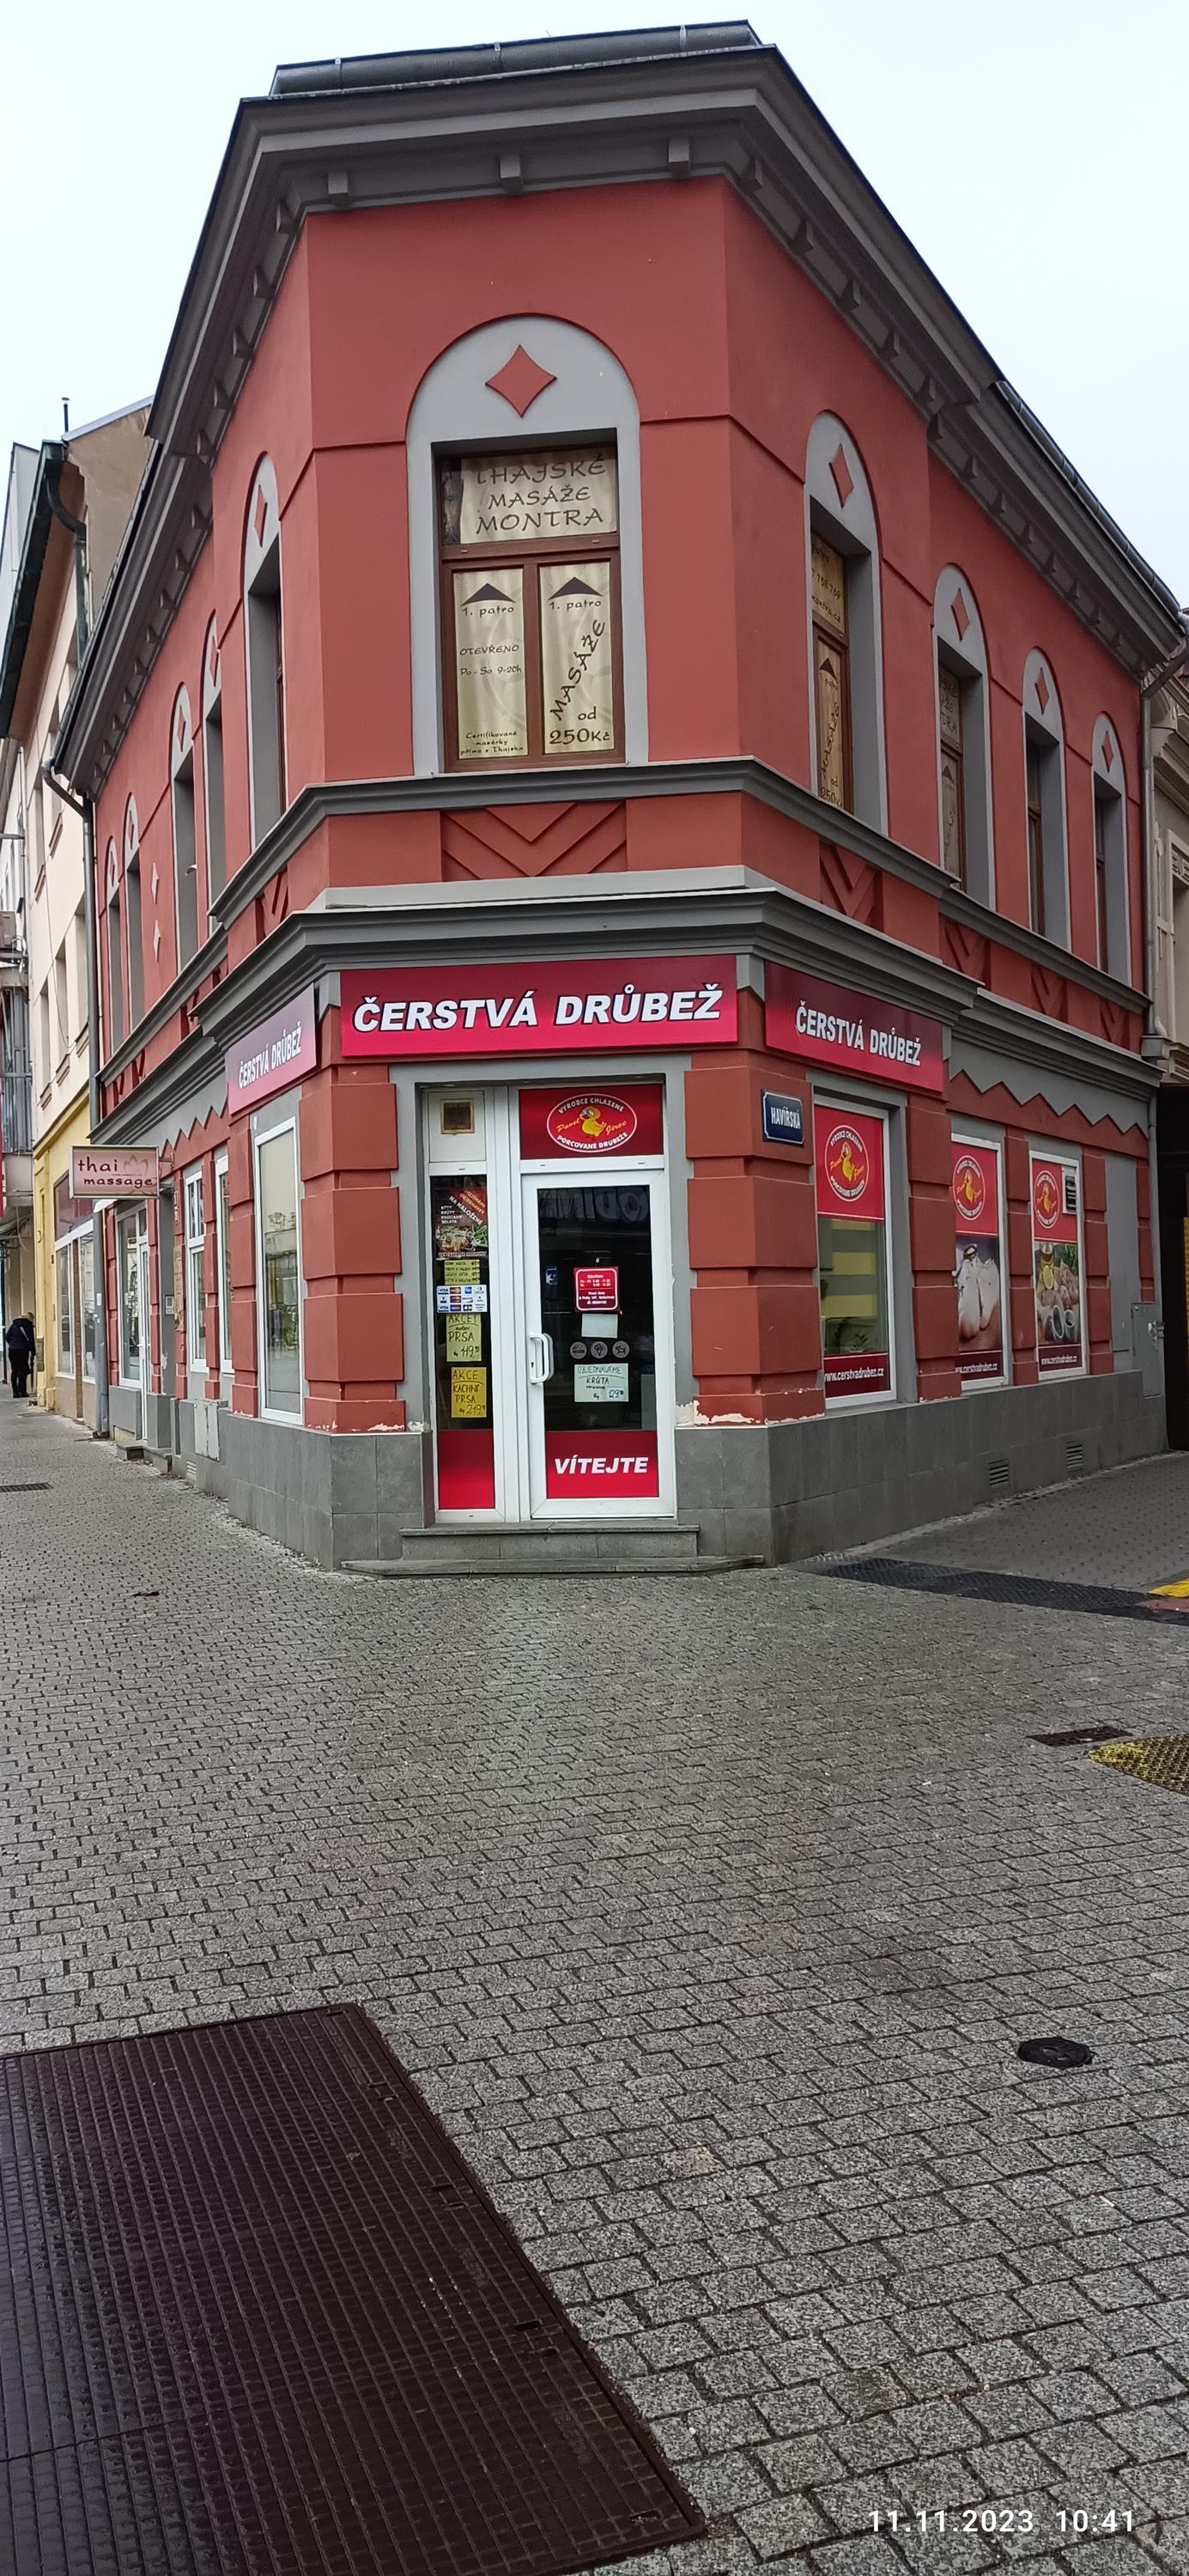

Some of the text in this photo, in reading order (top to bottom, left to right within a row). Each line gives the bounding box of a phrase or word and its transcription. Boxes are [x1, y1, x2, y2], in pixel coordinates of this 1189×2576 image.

[477, 454, 606, 484] THAJSKÉ
[488, 484, 591, 509] MASÁŽE
[476, 508, 604, 534] MONTRA
[480, 605, 514, 618] patro
[567, 599, 602, 611] patro
[460, 644, 519, 655] OTEVŘENO
[480, 666, 492, 675] So
[549, 619, 605, 720] MASÁŽE
[578, 706, 597, 720] od
[353, 983, 723, 1032] ČERSTVÁ DRŮBEŽ
[796, 999, 921, 1066] ČERSTVÁ DRŮBEŽ
[239, 1020, 301, 1089] ČERSTVÁ DRŮBEŽ
[556, 1118, 580, 1133] Pavel
[771, 1106, 801, 1129] HAVÍŘSKÁ
[78, 1156, 118, 1173] thai
[84, 1178, 153, 1188] massage
[448, 1332, 475, 1342] PRSA
[452, 1370, 478, 1380] AKCE
[455, 1394, 476, 1403] PRSA
[555, 1454, 649, 1474] VÍTEJTE
